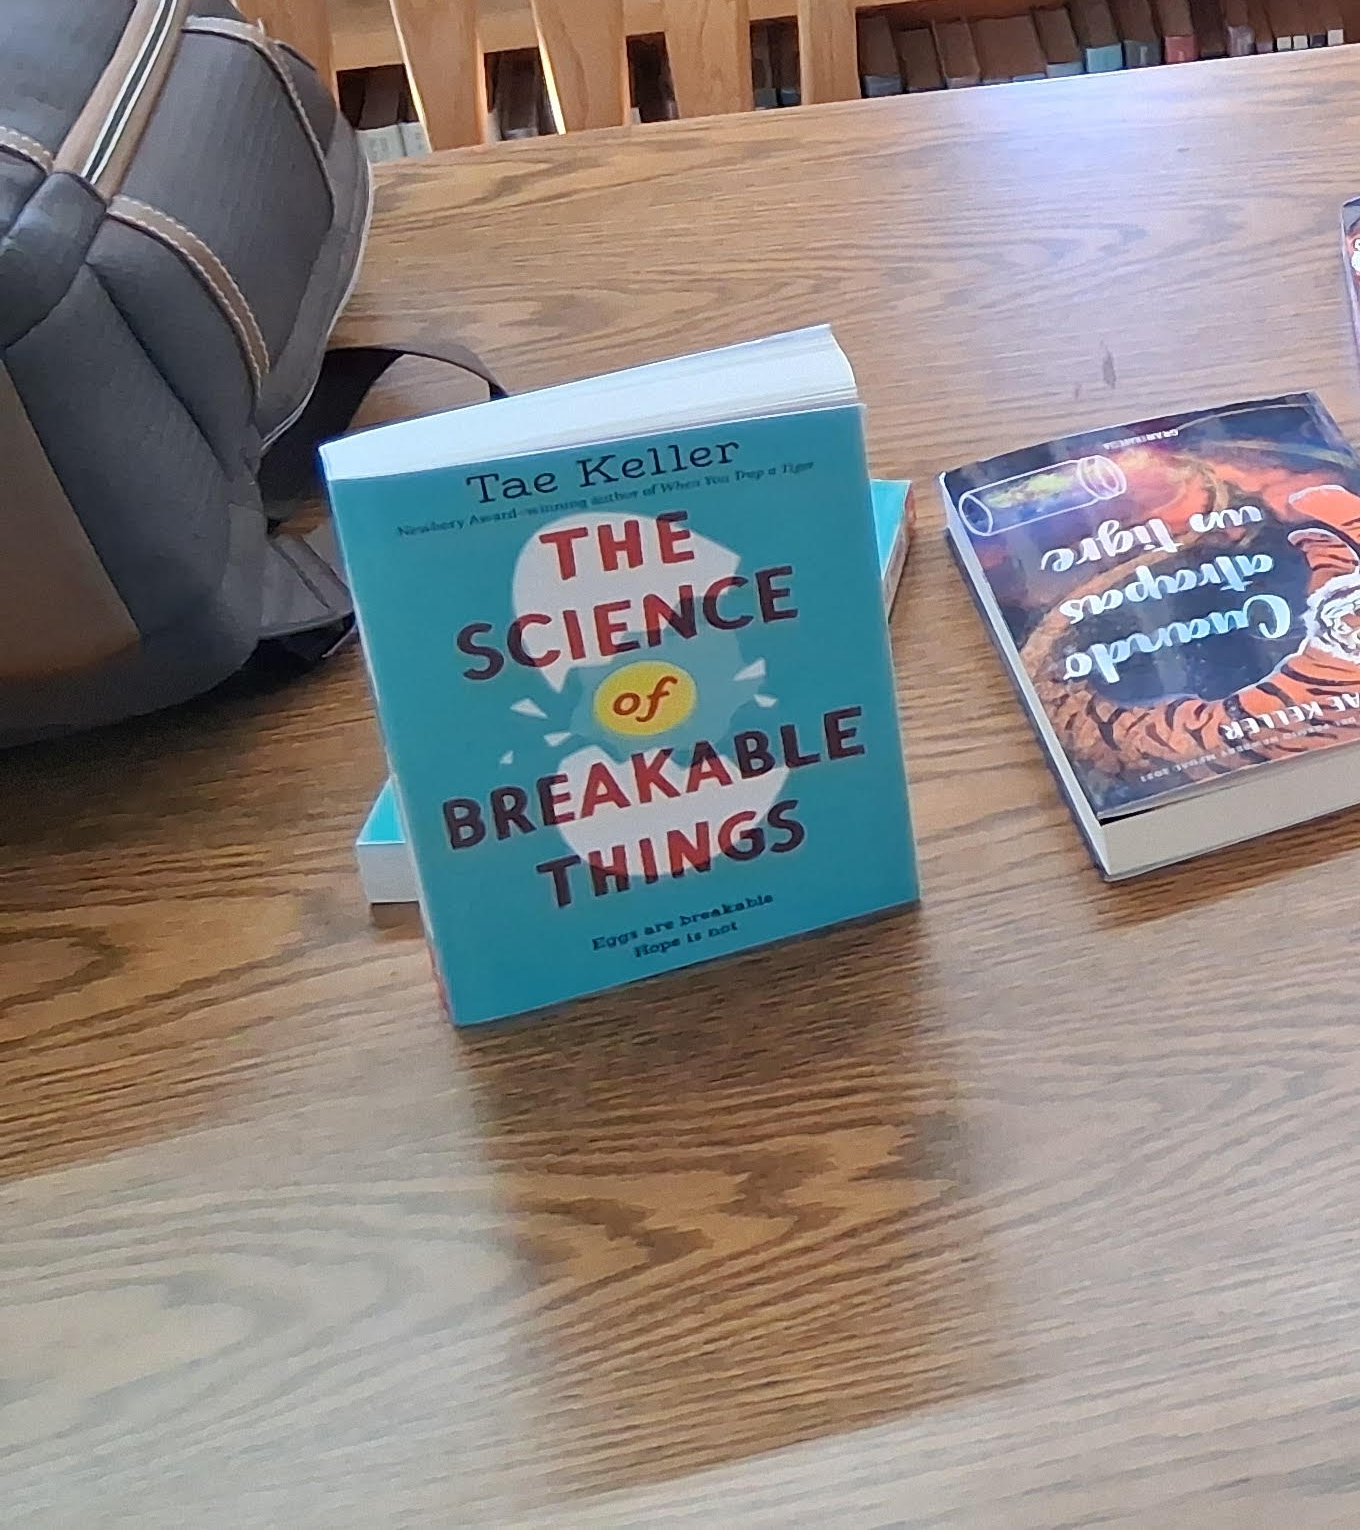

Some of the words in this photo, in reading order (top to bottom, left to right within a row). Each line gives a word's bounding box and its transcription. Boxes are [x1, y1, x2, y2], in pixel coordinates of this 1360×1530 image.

[396, 516, 465, 539] Newbery
[642, 482, 660, 499] of
[660, 475, 702, 494] When
[704, 471, 733, 488] You
[466, 471, 561, 506] Tae
[577, 438, 740, 491] Keller
[539, 510, 696, 582] THE
[1040, 517, 1183, 573] tigre
[1190, 503, 1264, 531] un
[1059, 551, 1275, 626] atrapas
[456, 566, 799, 683] SCIENCE
[1063, 593, 1293, 684] Cuando
[612, 675, 678, 724] of
[1220, 701, 1324, 741] KELLER
[442, 706, 866, 852] BREAKABLE
[536, 799, 807, 911] THINGS
[591, 925, 639, 952] Eggs
[642, 916, 676, 936] are
[678, 893, 774, 929] breakable
[633, 936, 682, 959] Hope
[686, 929, 704, 946] is
[706, 921, 740, 942] not
